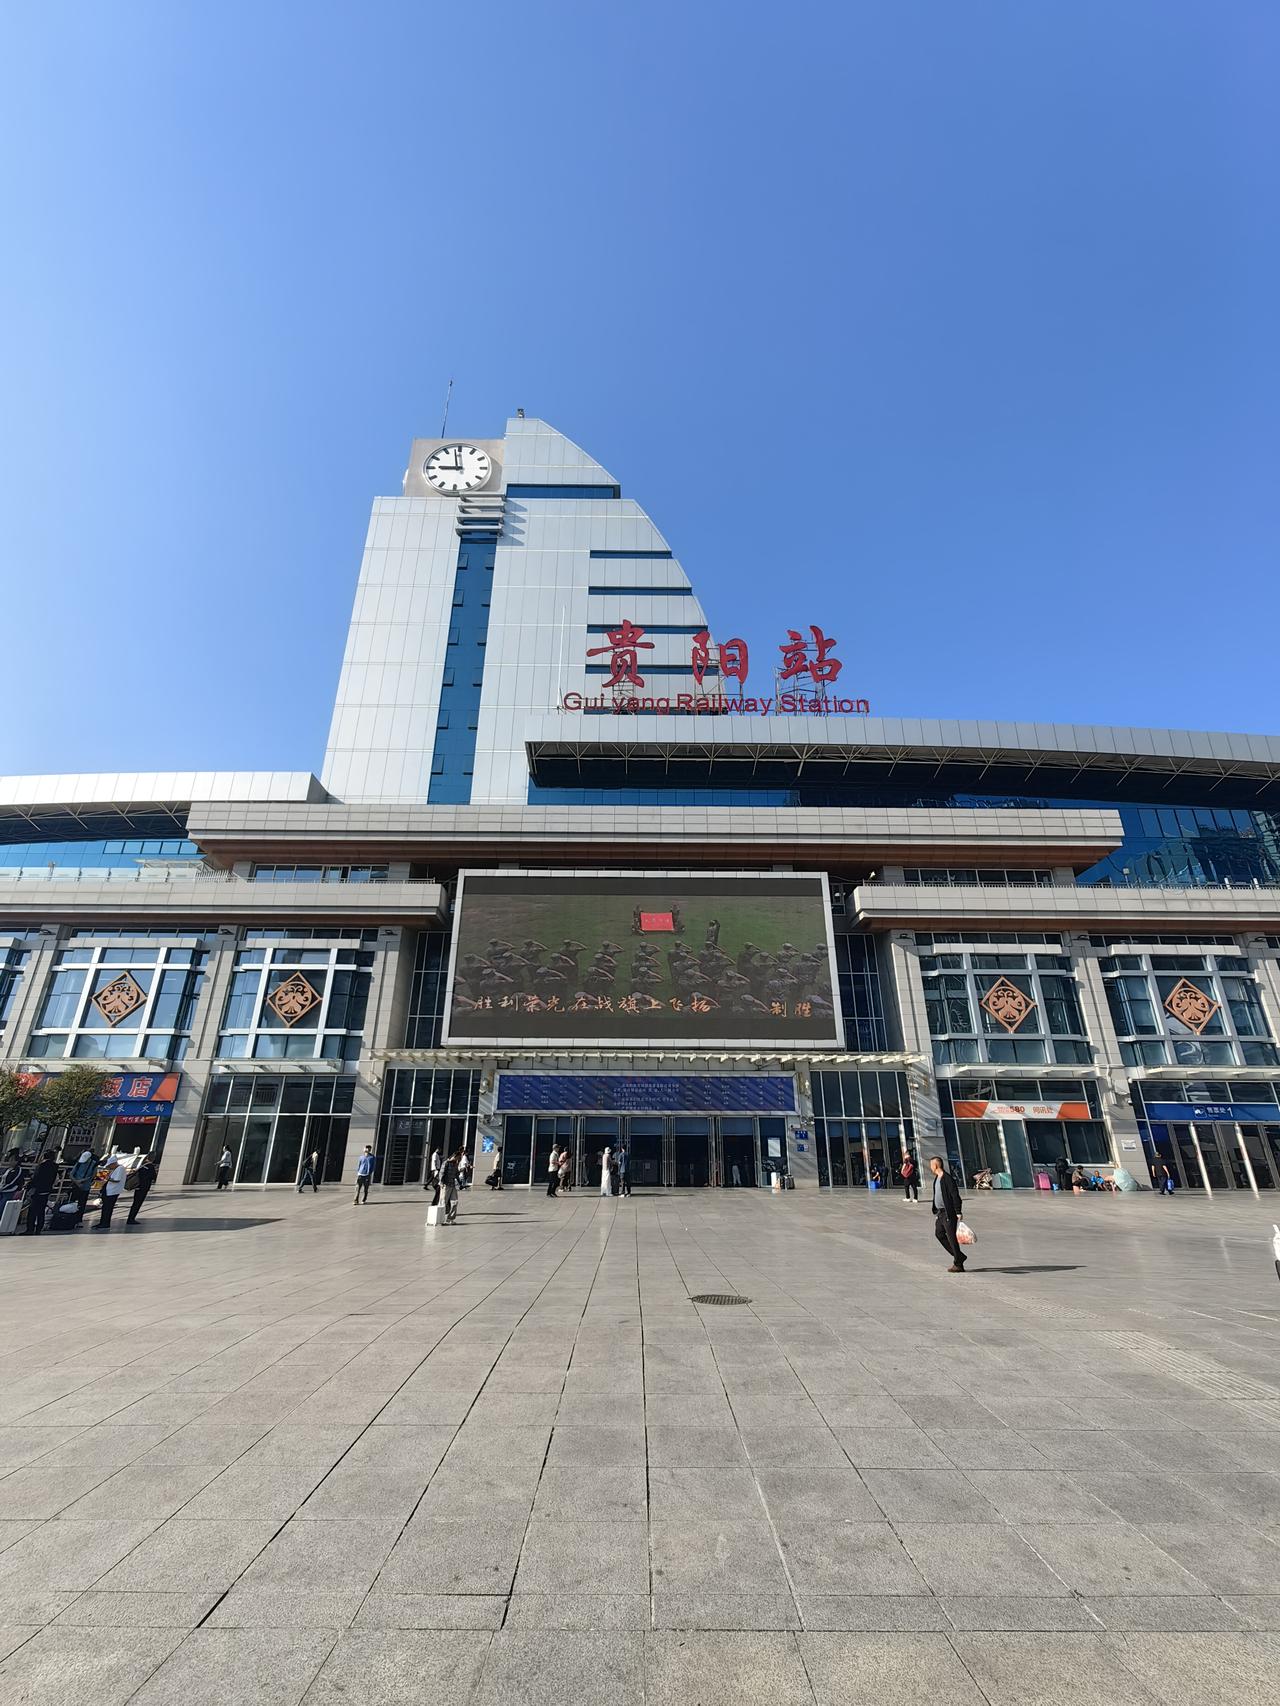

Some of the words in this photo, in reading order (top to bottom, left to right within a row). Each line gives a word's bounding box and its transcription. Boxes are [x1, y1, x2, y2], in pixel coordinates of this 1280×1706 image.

[586, 619, 843, 688] 贵阳站
[563, 692, 605, 711] Gui
[677, 693, 773, 716] Railway
[780, 693, 869, 713] Station
[769, 999, 813, 1018] 制胜
